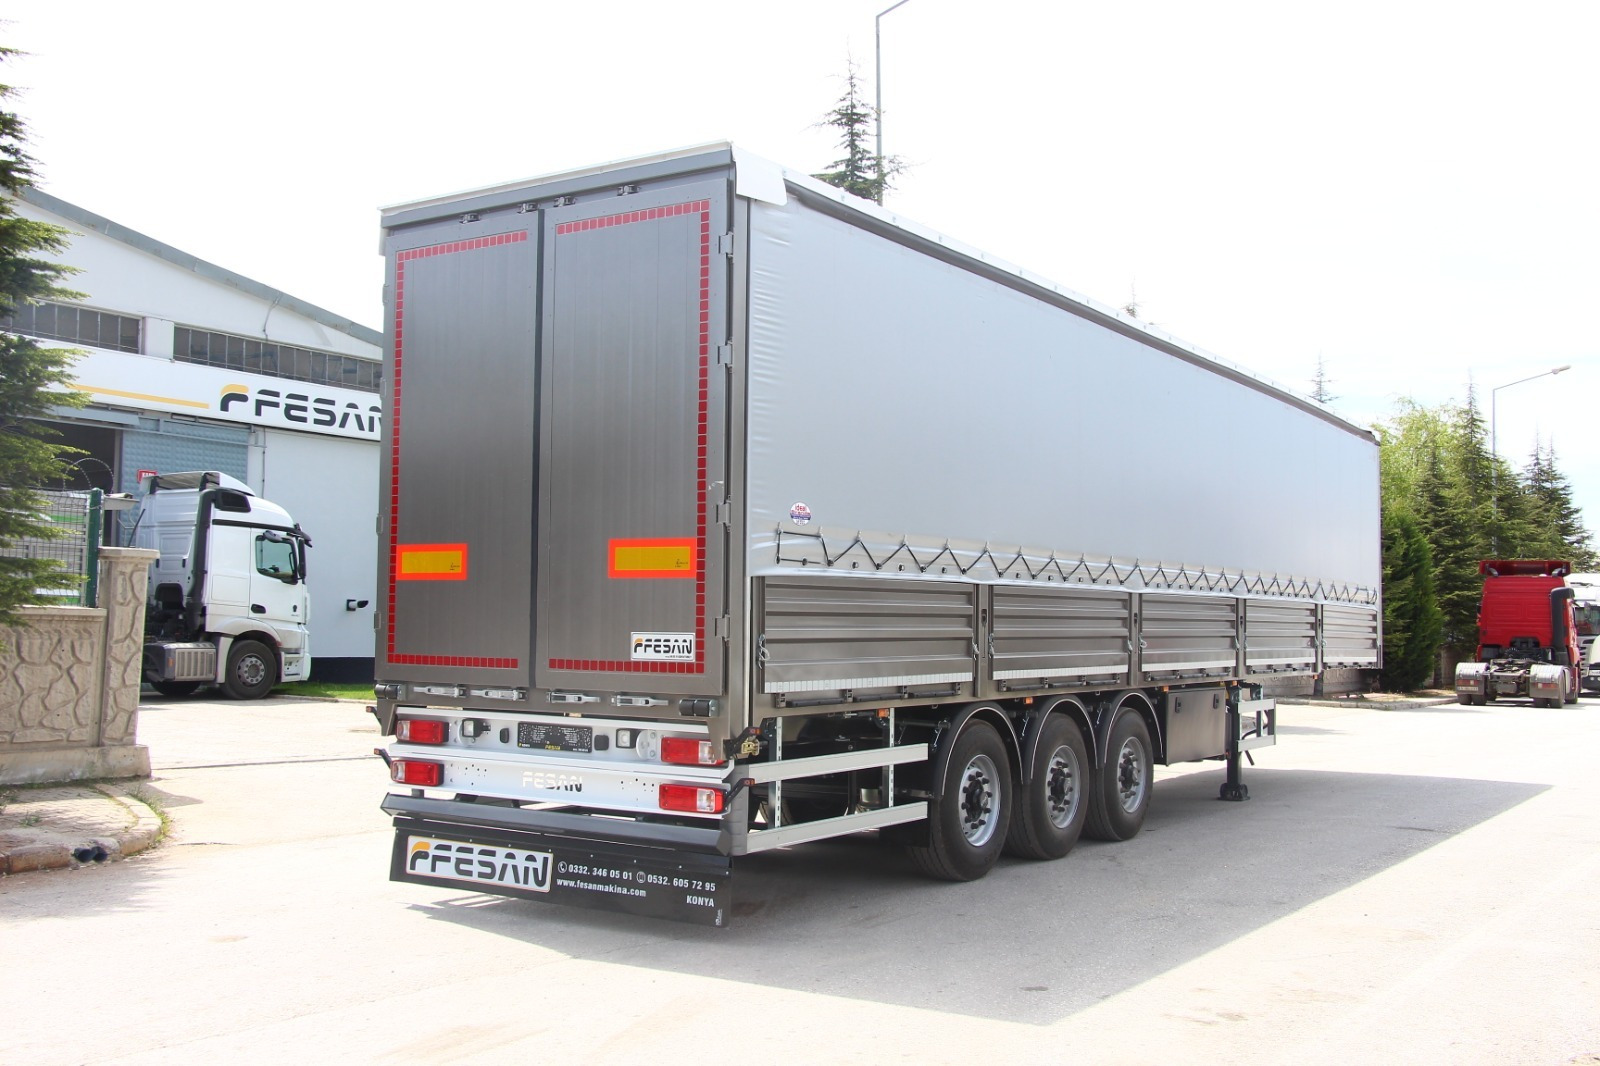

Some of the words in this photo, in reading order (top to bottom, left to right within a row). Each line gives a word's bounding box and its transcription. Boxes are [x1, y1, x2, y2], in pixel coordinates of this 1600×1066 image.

[644, 638, 692, 654] FESAN
[522, 771, 583, 793] FESAN
[431, 844, 549, 887] FESAN
[556, 878, 647, 897] www.fesanmakina.com
[592, 867, 608, 877] 346
[610, 869, 620, 879] 05
[622, 871, 633, 881] 01
[673, 878, 689, 888] 605
[692, 880, 703, 890] 72
[705, 882, 716, 892] 95
[686, 895, 715, 908] KONYA
